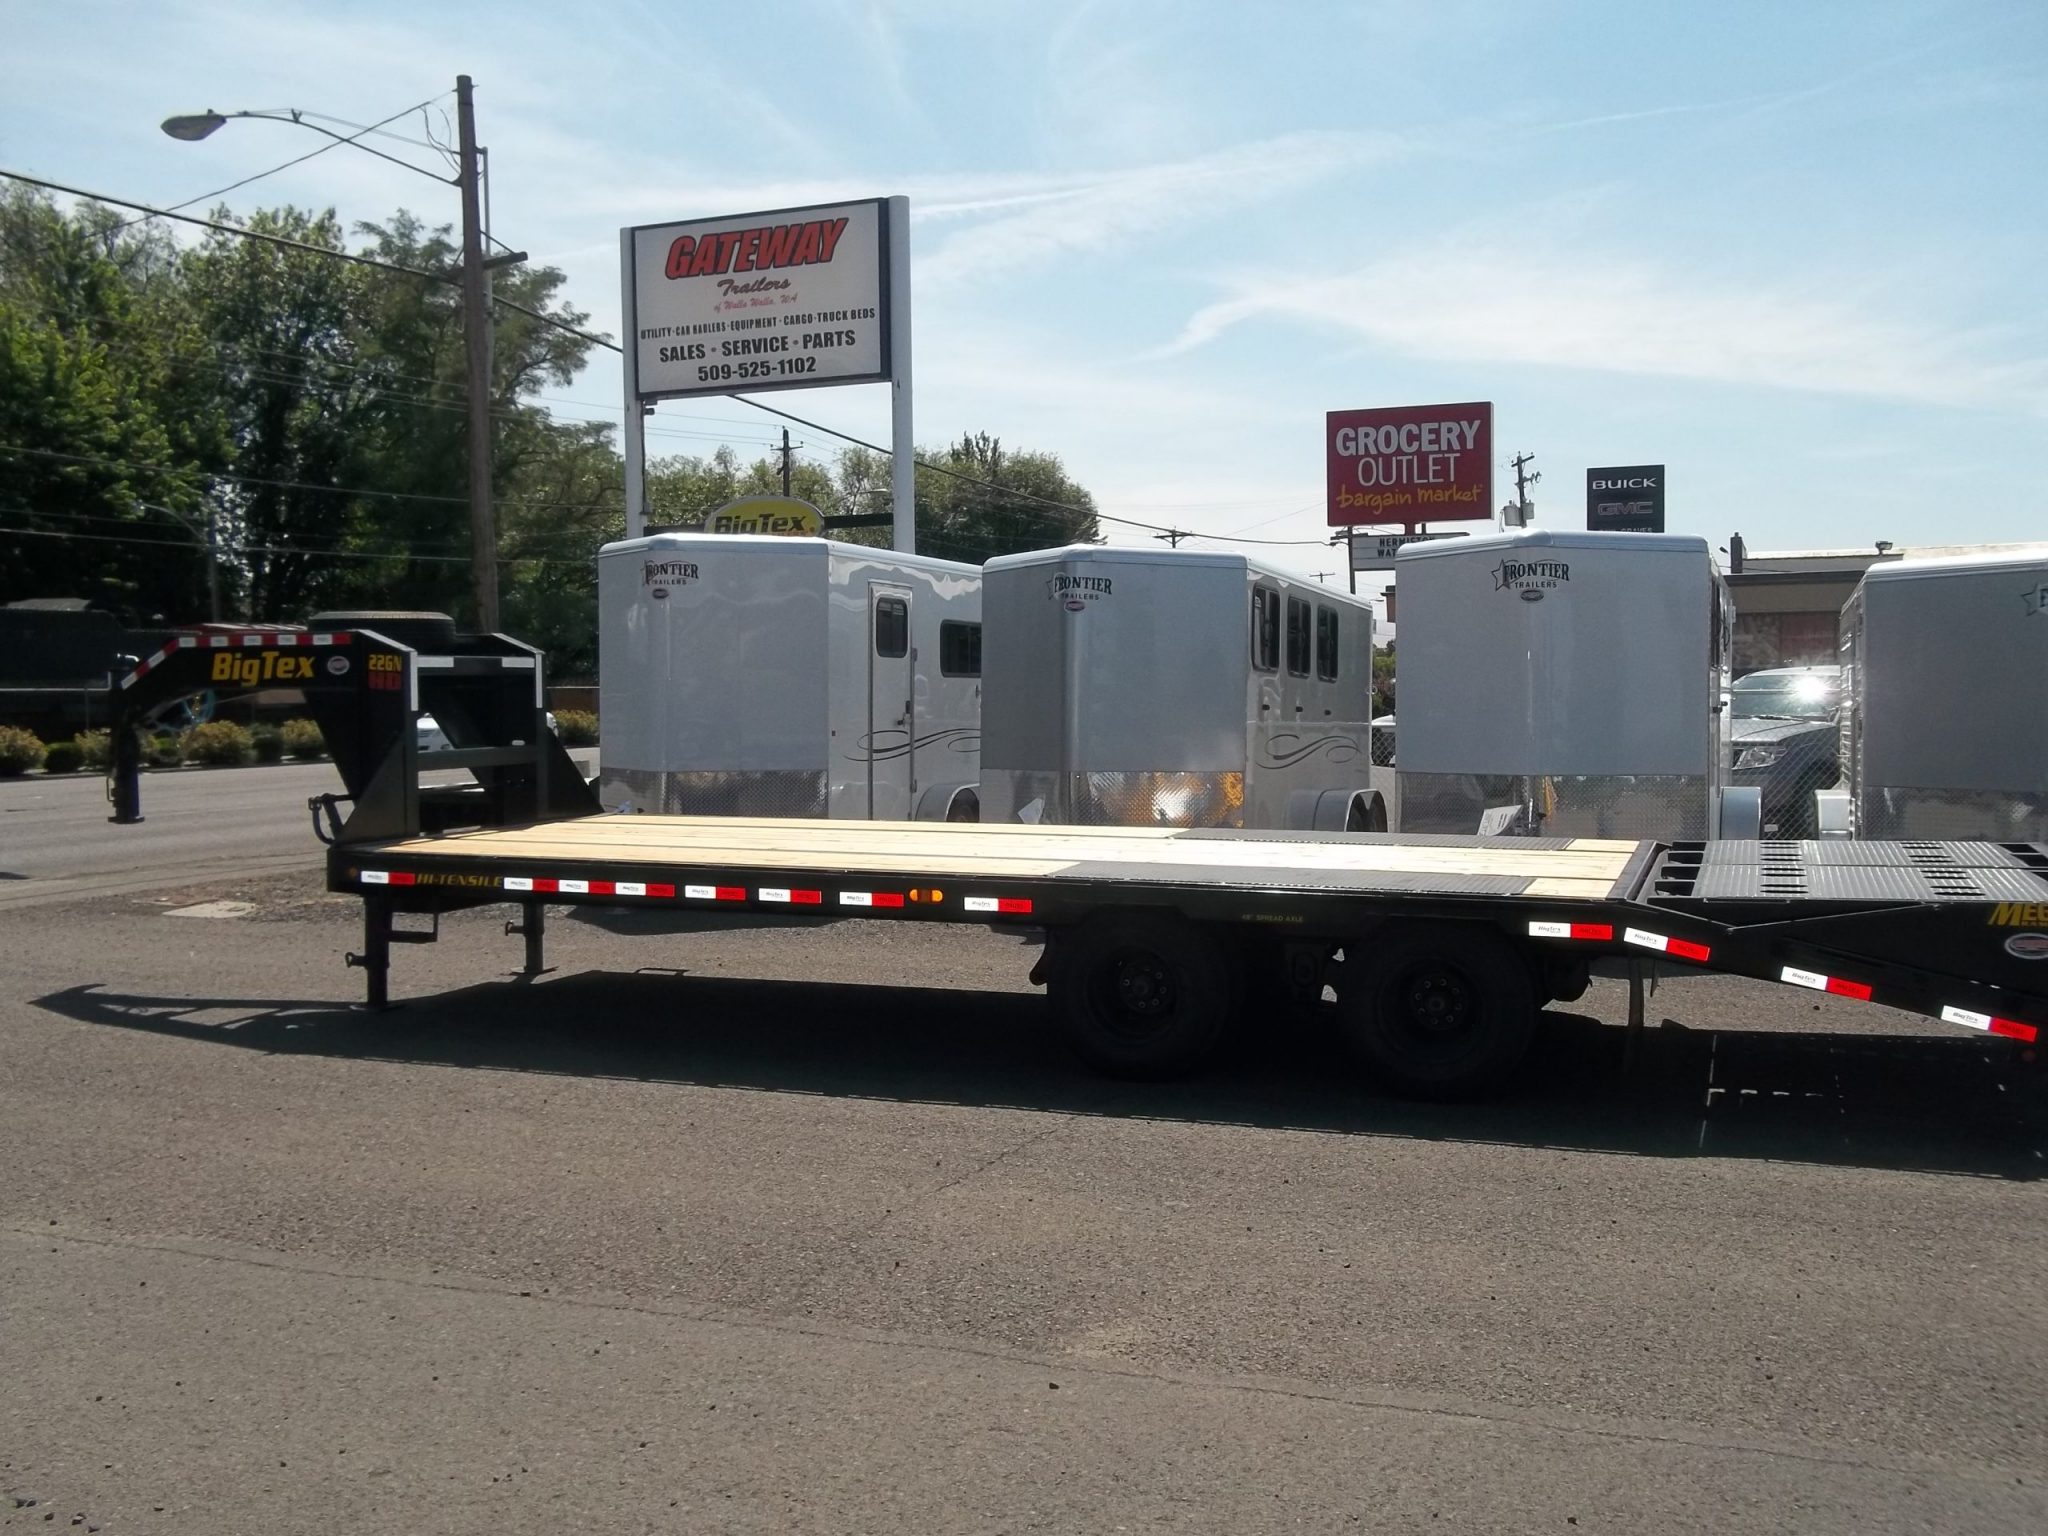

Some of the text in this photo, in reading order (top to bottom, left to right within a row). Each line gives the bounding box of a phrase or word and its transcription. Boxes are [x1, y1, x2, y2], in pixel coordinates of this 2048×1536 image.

[664, 217, 849, 280] GATEWAY
[717, 276, 791, 297] Trailers
[692, 321, 726, 335] HAULERS
[730, 317, 777, 332] EQUIPMENT
[783, 313, 813, 326] CARGO
[817, 310, 848, 323] TRUCK
[851, 308, 876, 320] BEDS
[659, 329, 856, 363] SALES SERVICE PARTS
[698, 356, 816, 382] 509-525-1102
[1336, 420, 1481, 456] GROCERY
[1358, 453, 1461, 486] OUTLET
[1592, 478, 1657, 490] BUICK
[1336, 483, 1481, 515] bargain market
[1597, 501, 1653, 516] GMC
[1502, 562, 1569, 583] FRONTIER
[1515, 581, 1557, 589] TRAILERS
[212, 651, 315, 687] BigTex
[416, 873, 503, 888] HI-TENSILE
